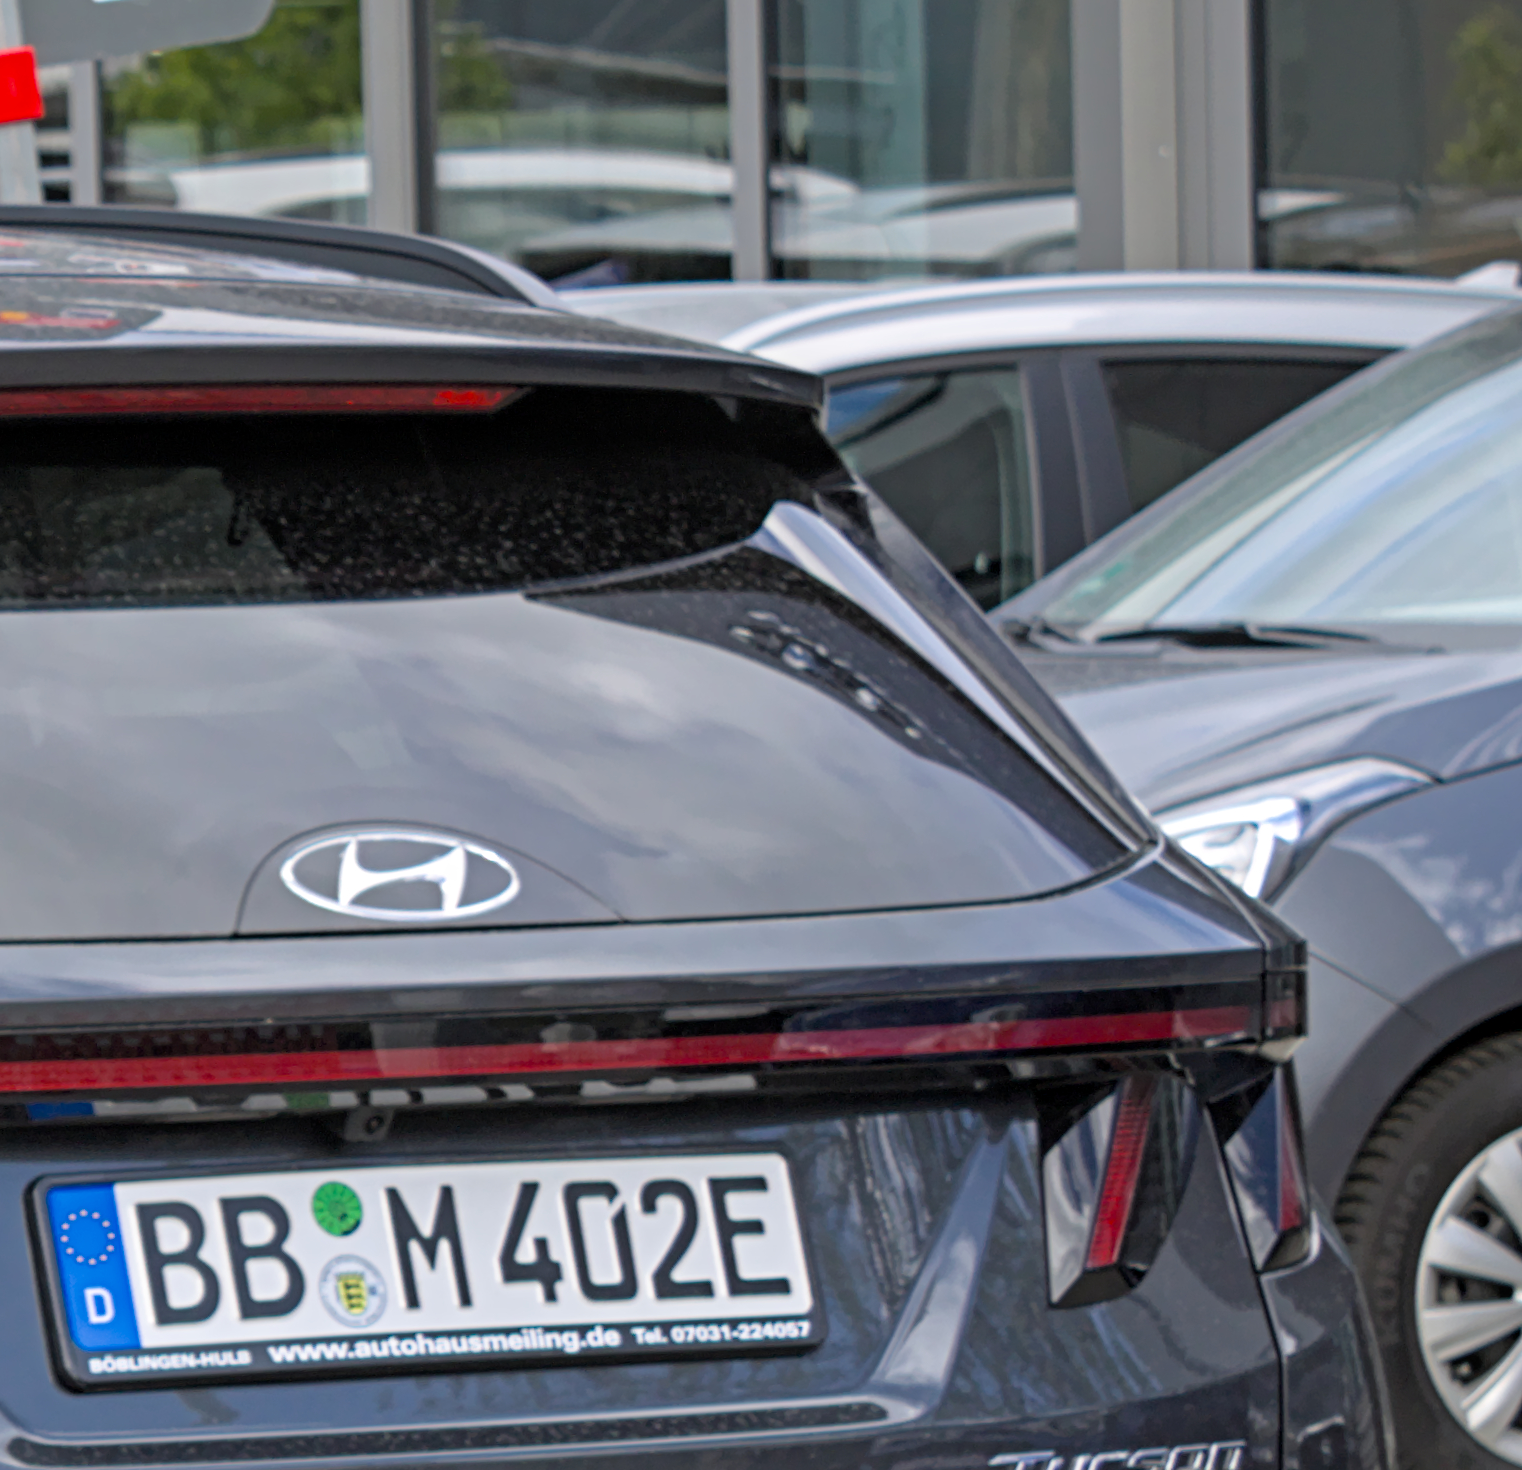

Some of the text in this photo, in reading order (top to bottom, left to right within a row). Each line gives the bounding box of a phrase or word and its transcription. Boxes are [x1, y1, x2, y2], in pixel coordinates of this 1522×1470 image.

[134, 1196, 306, 1326] BB
[385, 1184, 473, 1310] M
[499, 1175, 792, 1303] 402E
[87, 1287, 116, 1326] D
[88, 1320, 811, 1374] BÖBLINGEN-HULB www.autohausmeiling.de Tel. 07031-224057
